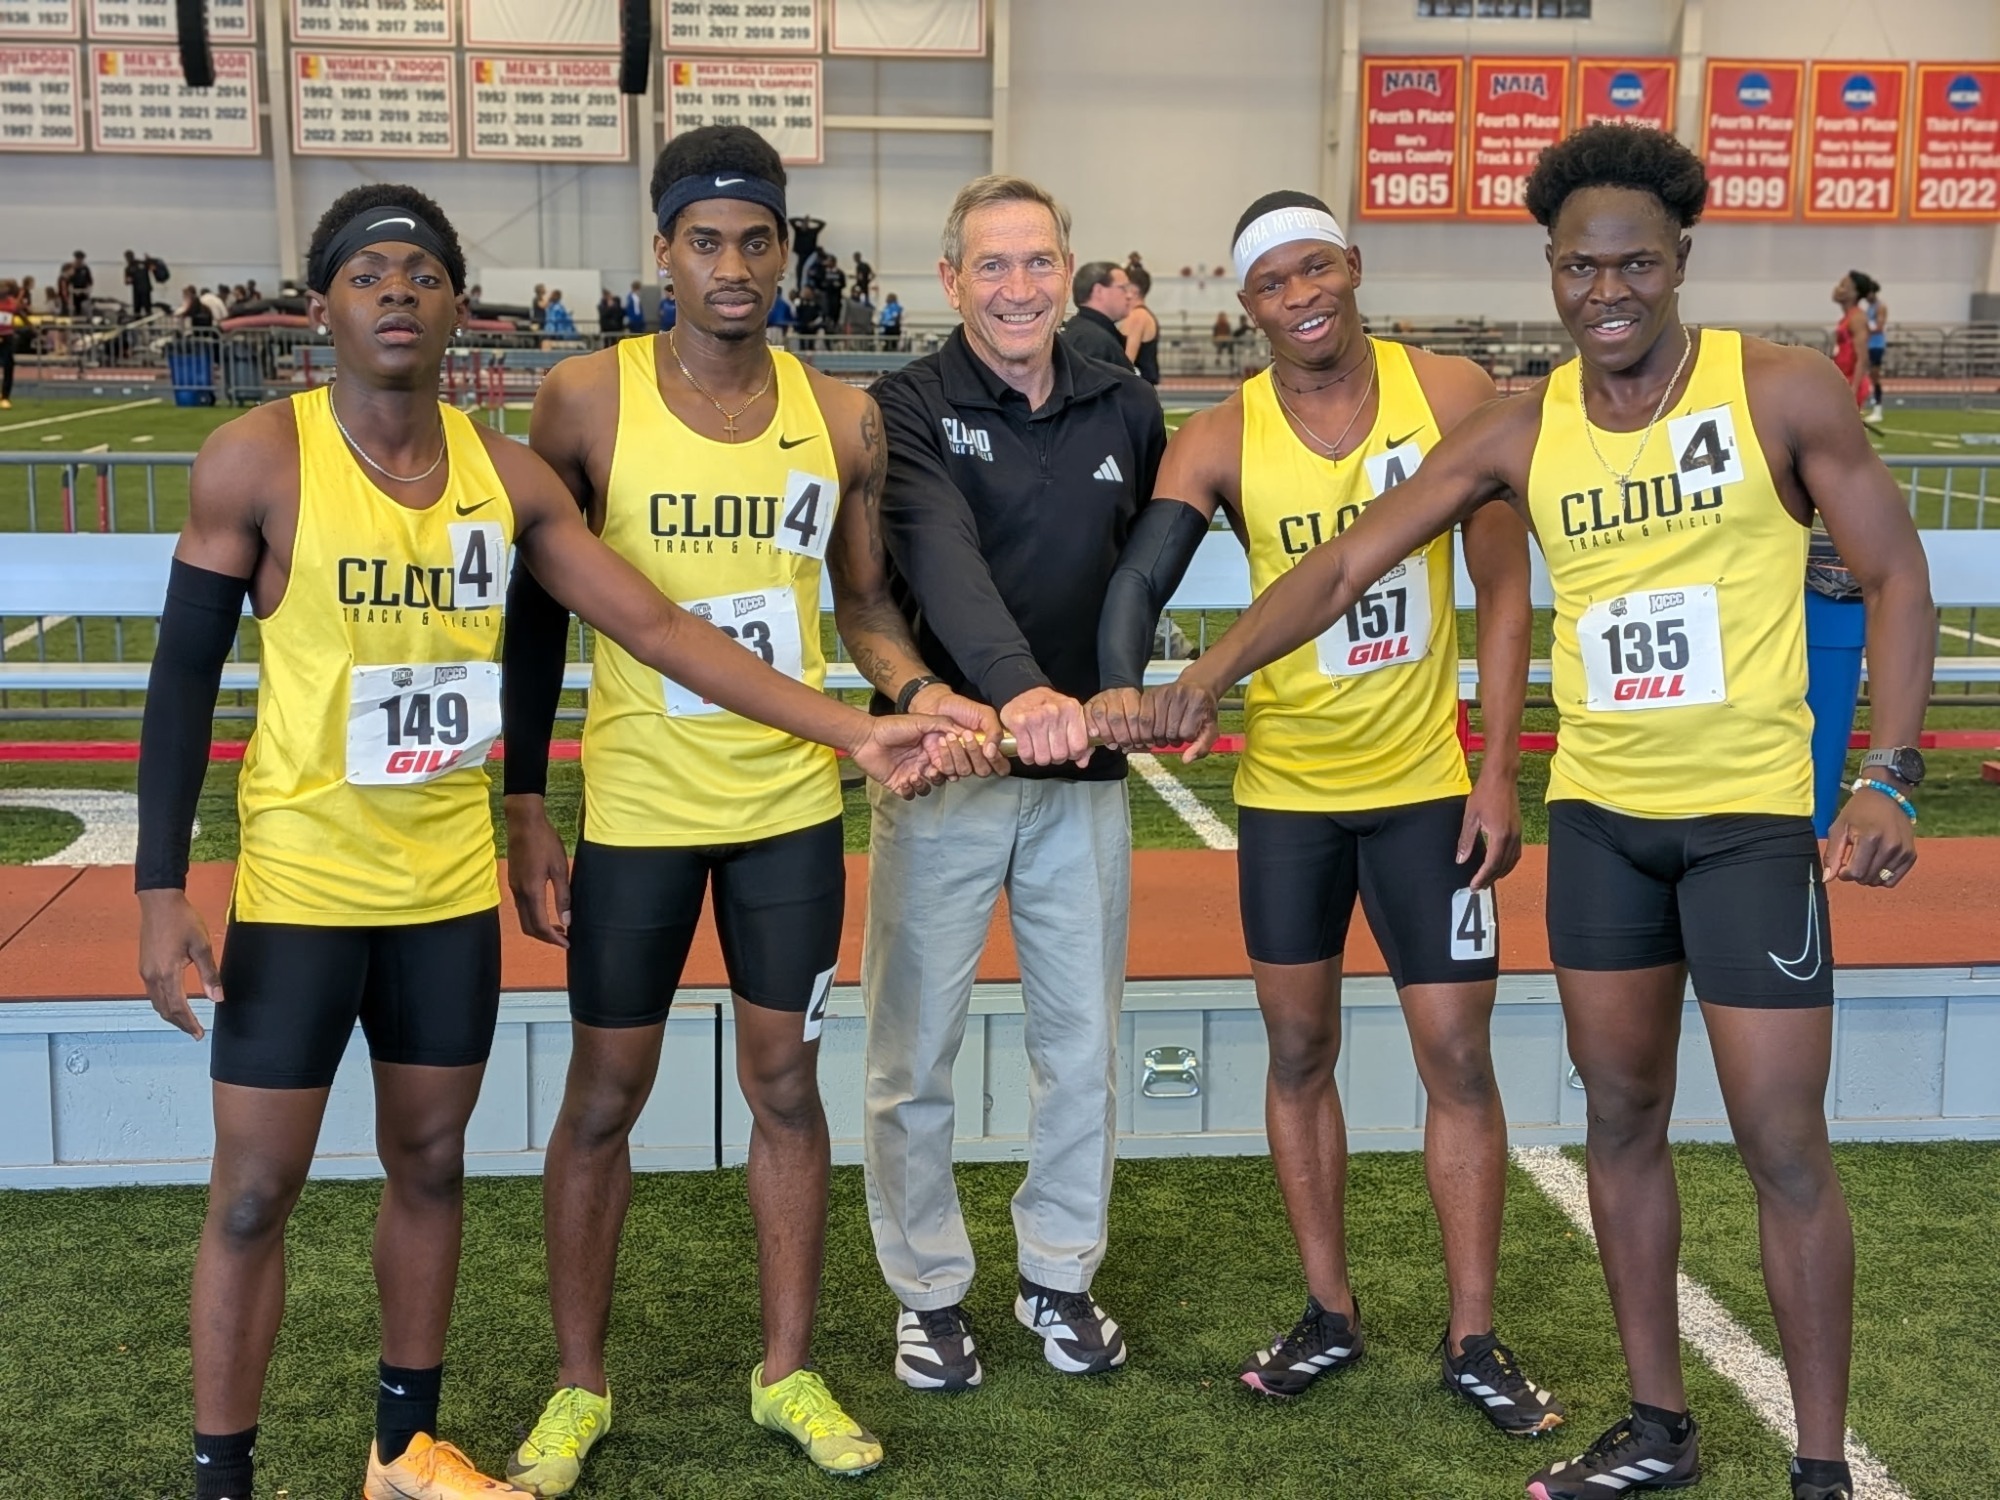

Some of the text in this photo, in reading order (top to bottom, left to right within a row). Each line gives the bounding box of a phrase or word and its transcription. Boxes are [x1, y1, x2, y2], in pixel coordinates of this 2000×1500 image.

[300, 17, 330, 30] 2015
[377, 19, 406, 32] 2017
[672, 25, 700, 37] 2011
[709, 26, 738, 38] 2017
[780, 27, 810, 39] 2019
[124, 54, 172, 66] MEN'S
[327, 58, 444, 72] WOMEN'S INDOOR
[505, 62, 611, 76] MEN'S INDOOR
[697, 65, 812, 76] MEN'S CROSS COUNTRY
[139, 84, 169, 96] 2012
[697, 78, 756, 87] CONFERENCE
[1384, 71, 1440, 95] NAIA
[1492, 75, 1546, 96] NAIA
[550, 93, 580, 104] 2014
[587, 94, 616, 105] 2015
[303, 107, 333, 119] 2017
[477, 113, 507, 124] 2017
[1369, 108, 1455, 125] Fourth Place
[1477, 113, 1560, 128] Fourth Place
[1710, 114, 1794, 131] Fourth Place
[1816, 116, 1859, 132] Fourth
[1926, 117, 1959, 132] Third
[1395, 134, 1427, 147] Men's
[1481, 137, 1511, 148] Men's
[1369, 149, 1454, 166] Cross Country
[1475, 150, 1511, 165] Track
[1709, 151, 1744, 166] Track
[1760, 153, 1790, 167] Field
[1814, 154, 1848, 169] Track
[1864, 154, 1895, 169] Field
[1370, 174, 1449, 206] 1965
[1477, 174, 1529, 206] 198
[1710, 176, 1785, 207] 1999
[1815, 177, 1891, 209] 2021
[1919, 177, 1997, 209] 2022
[1239, 221, 1269, 258] ALPHA
[1680, 419, 1731, 475] 4
[650, 493, 787, 539] CLOU
[784, 482, 822, 547] 4
[1569, 513, 1722, 553] TRACK & FIELD
[654, 539, 739, 554] TRACK &
[458, 529, 493, 598] 4
[338, 558, 490, 612] CLOU
[343, 608, 402, 624] TRACK
[422, 612, 429, 625] &
[1346, 587, 1406, 642] 157
[1348, 636, 1411, 666] GILL
[1601, 618, 1690, 675] 135
[1614, 674, 1686, 702] GILL
[379, 692, 468, 746] 149
[1457, 893, 1487, 952] 4
